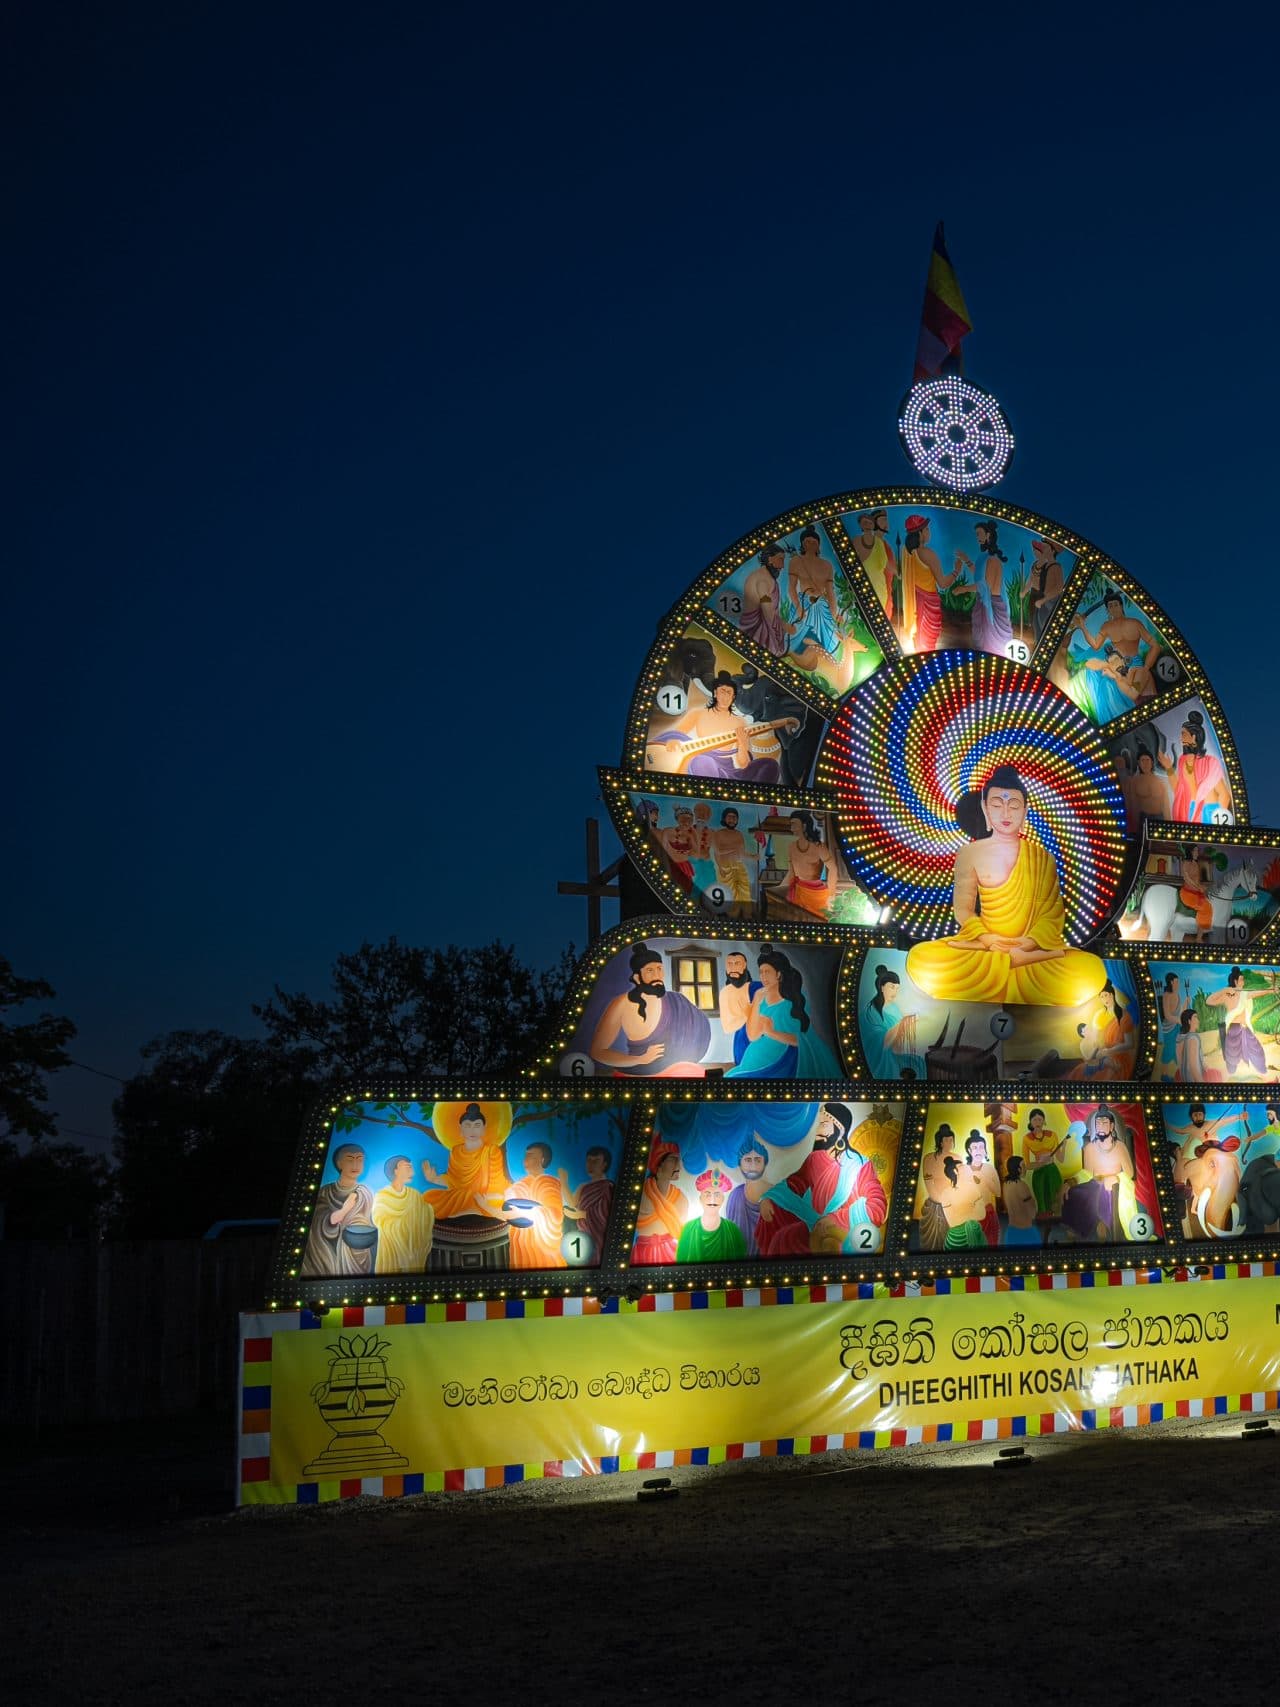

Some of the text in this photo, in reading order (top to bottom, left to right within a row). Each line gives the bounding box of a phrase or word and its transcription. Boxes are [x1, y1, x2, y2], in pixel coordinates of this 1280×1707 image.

[721, 597, 742, 614] 13
[1008, 644, 1027, 661] 15
[1159, 662, 1176, 678] 14
[662, 692, 683, 709] 11
[1213, 813, 1229, 826] 12
[711, 887, 724, 907] 9
[1230, 923, 1247, 940] 10
[997, 1018, 1008, 1033] 7
[571, 1058, 585, 1077] 6
[1136, 1217, 1148, 1236] 3
[570, 1237, 582, 1258] 1
[859, 1229, 873, 1249] 2
[951, 1311, 1089, 1361] කෝසල
[1103, 1307, 1229, 1350] ජාතකය
[679, 1362, 762, 1391] විහාරය
[878, 1372, 1012, 1408] DHEEGHITHI
[1019, 1365, 1107, 1397] KOSAL
